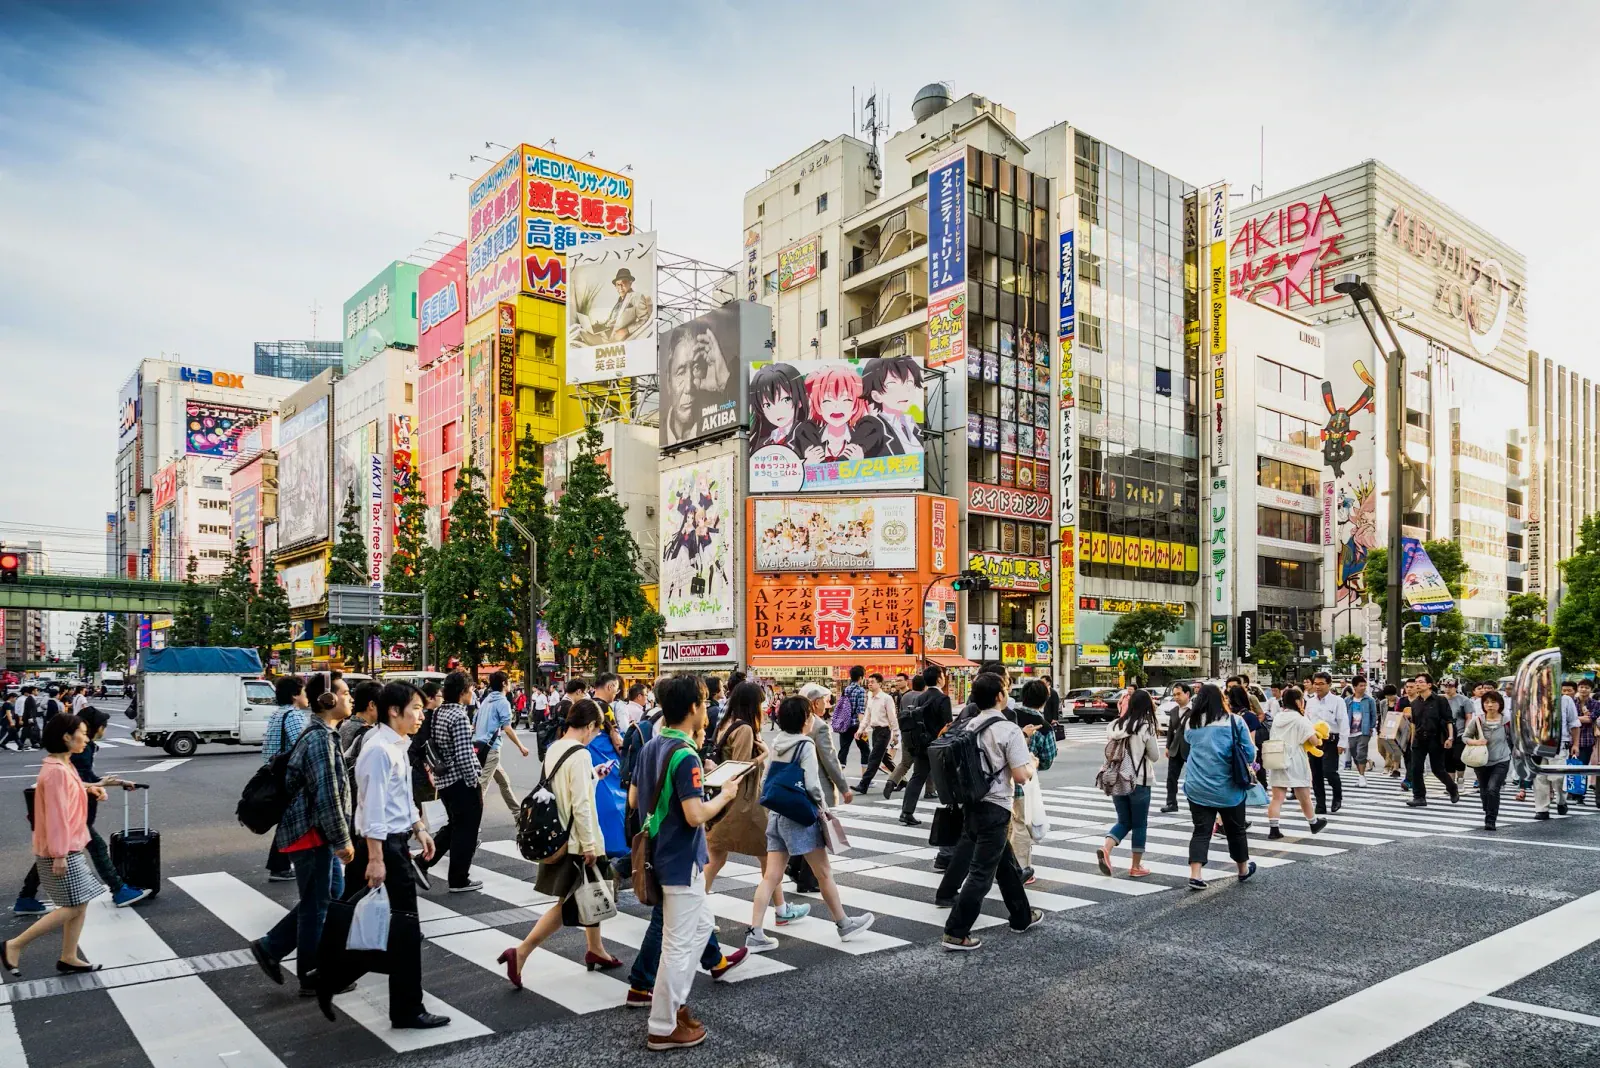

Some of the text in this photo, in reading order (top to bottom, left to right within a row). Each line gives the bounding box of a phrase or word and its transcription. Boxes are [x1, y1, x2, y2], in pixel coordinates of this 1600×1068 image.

[528, 181, 630, 233] 激安販売
[1230, 193, 1342, 257] AKIBA
[470, 216, 519, 277] 高額買取
[421, 281, 459, 333] SEGA
[1213, 266, 1222, 349] Yellow Submarine
[595, 357, 626, 371] 英会話
[596, 345, 626, 359] DMM
[984, 366, 998, 380] 6F
[702, 409, 736, 431] AKIBA
[984, 432, 998, 446] 5F
[372, 456, 382, 491] AKKY
[972, 487, 1050, 517] メイドカジノ
[372, 502, 382, 550] Tax-free
[934, 503, 945, 548] 買取
[372, 552, 382, 581] Shop
[760, 557, 874, 568] Welcome to Akihabara
[969, 554, 1040, 579] まんが喫茶
[1212, 506, 1226, 601] リバティー
[772, 588, 784, 634] アイドル
[786, 588, 798, 621] アニメ
[800, 587, 812, 635] 美少女系
[816, 588, 852, 648] 買取
[858, 588, 870, 634] フィギュア
[872, 588, 884, 621] ホビー
[886, 587, 899, 635] 携帯電話
[661, 643, 718, 661] ZIN COMIC ZIN
[773, 637, 897, 649] チケット 大黒屋
